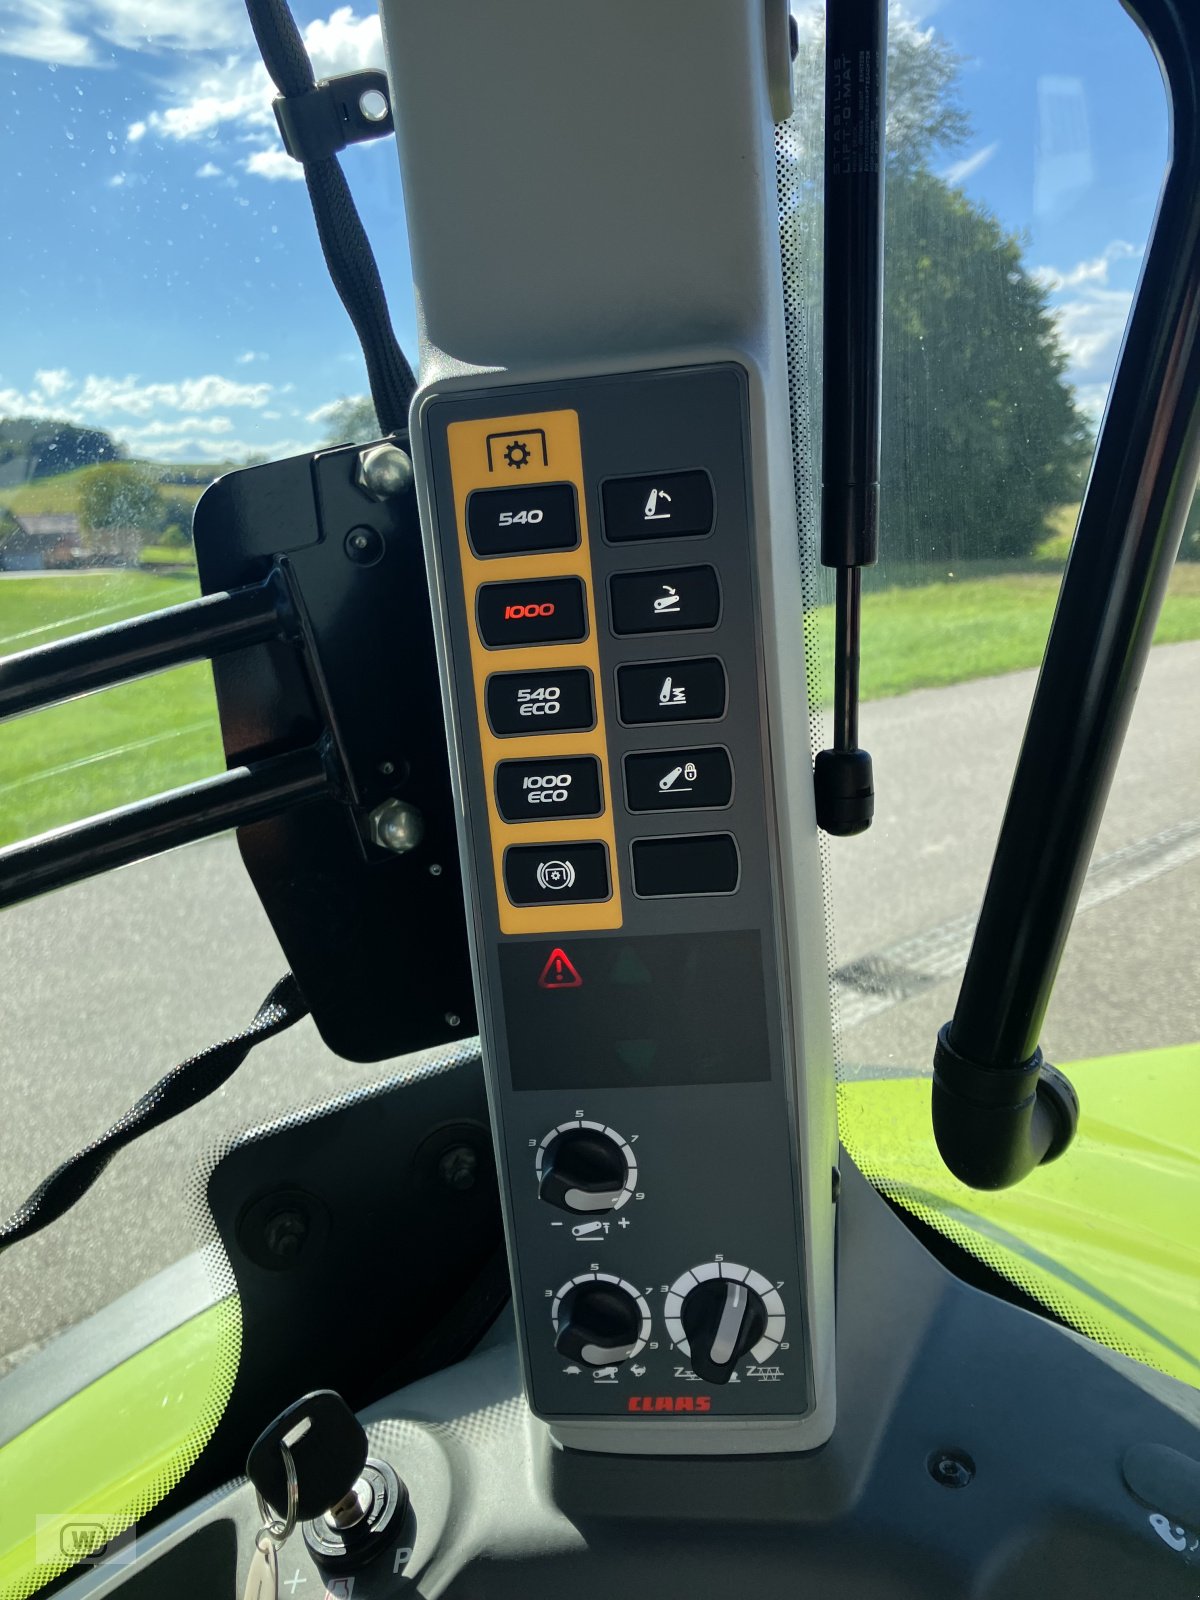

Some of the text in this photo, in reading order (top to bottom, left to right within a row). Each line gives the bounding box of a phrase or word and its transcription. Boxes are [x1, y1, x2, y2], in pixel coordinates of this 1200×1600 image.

[833, 57, 841, 176] STABILUS
[498, 509, 544, 526] 540
[504, 603, 555, 620] 1000
[517, 687, 561, 702] 540
[519, 701, 561, 716] ECO
[522, 774, 572, 789] 1000
[527, 789, 568, 804] ECO
[575, 1109, 584, 1118] 5
[528, 1139, 537, 1147] 3
[630, 1134, 639, 1143] 7
[635, 1192, 645, 1200] 9
[590, 1263, 599, 1271] 5
[544, 1289, 553, 1297] 3
[645, 1287, 653, 1295] 7
[660, 1285, 669, 1293] 3
[649, 1341, 659, 1350] 9
[780, 1342, 790, 1350] 9
[628, 1396, 710, 1411] CLAAS
[393, 1548, 413, 1574] P
